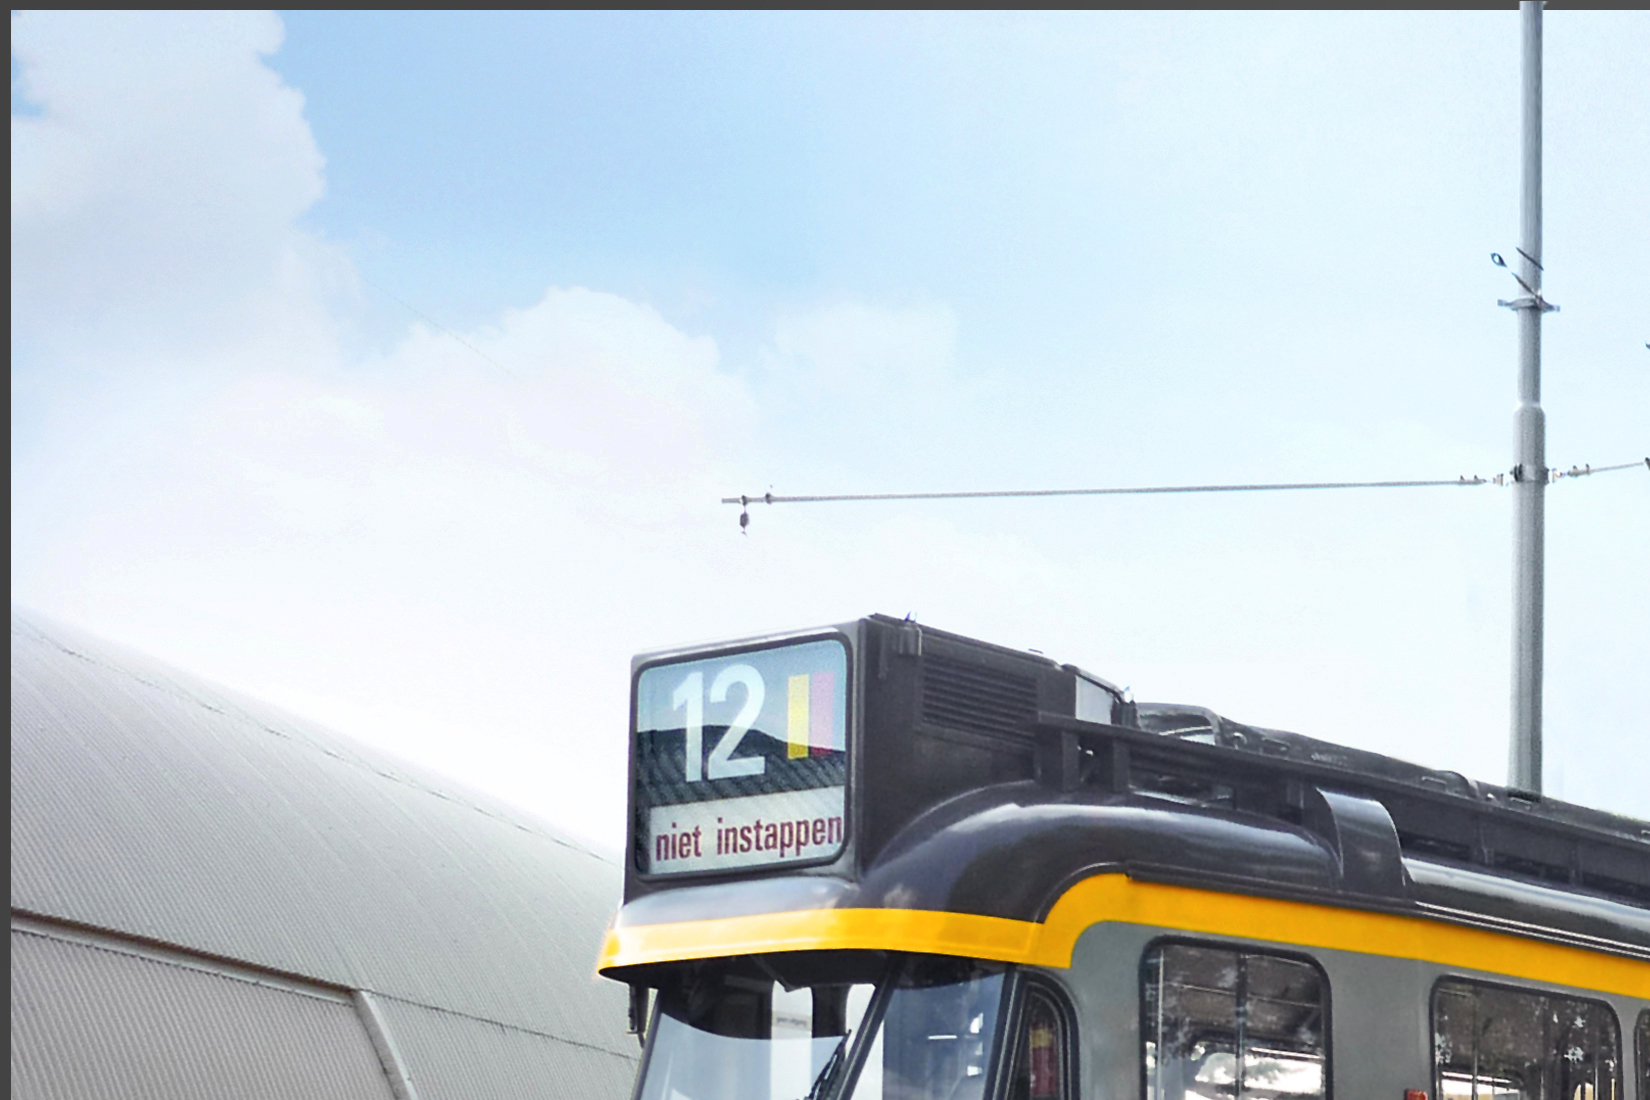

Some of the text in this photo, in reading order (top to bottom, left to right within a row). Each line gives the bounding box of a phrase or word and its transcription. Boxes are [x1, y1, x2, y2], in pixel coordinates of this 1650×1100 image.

[672, 664, 765, 782] 12
[655, 816, 843, 861] niet instappen
